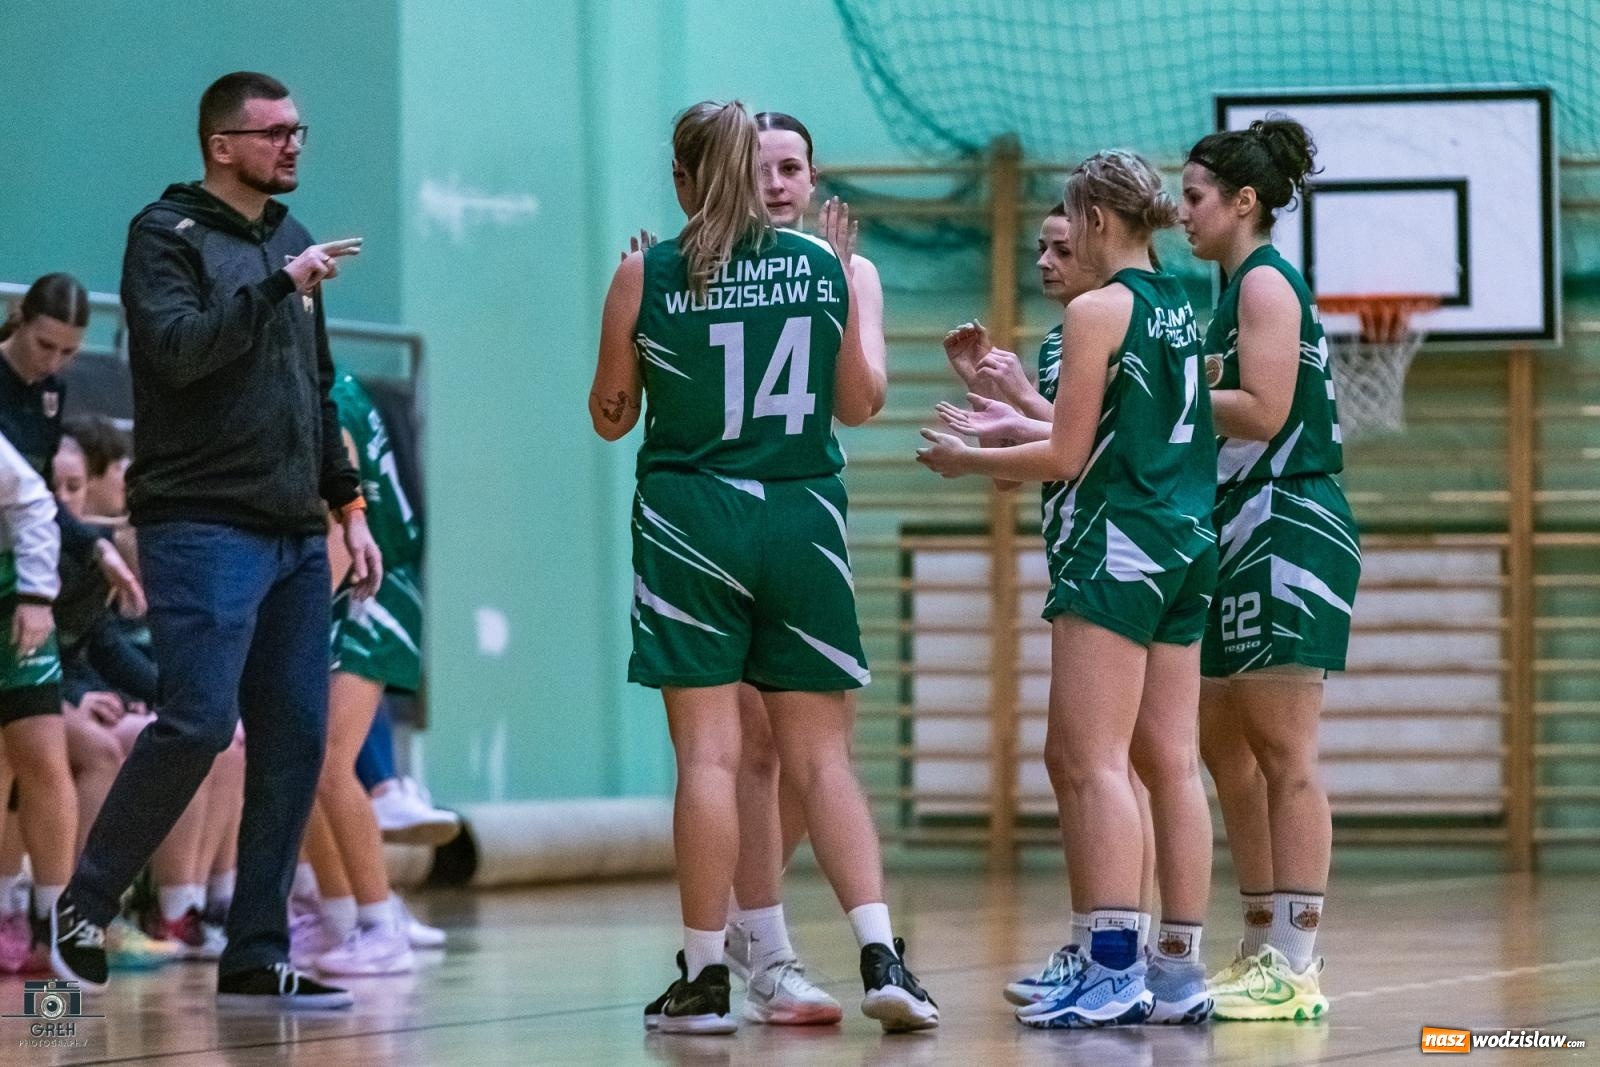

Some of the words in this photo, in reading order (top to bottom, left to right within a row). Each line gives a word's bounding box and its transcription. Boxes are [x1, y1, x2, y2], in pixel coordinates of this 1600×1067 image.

[709, 315, 816, 441] 14
[1221, 592, 1261, 640] 22
[1224, 640, 1261, 653] regio
